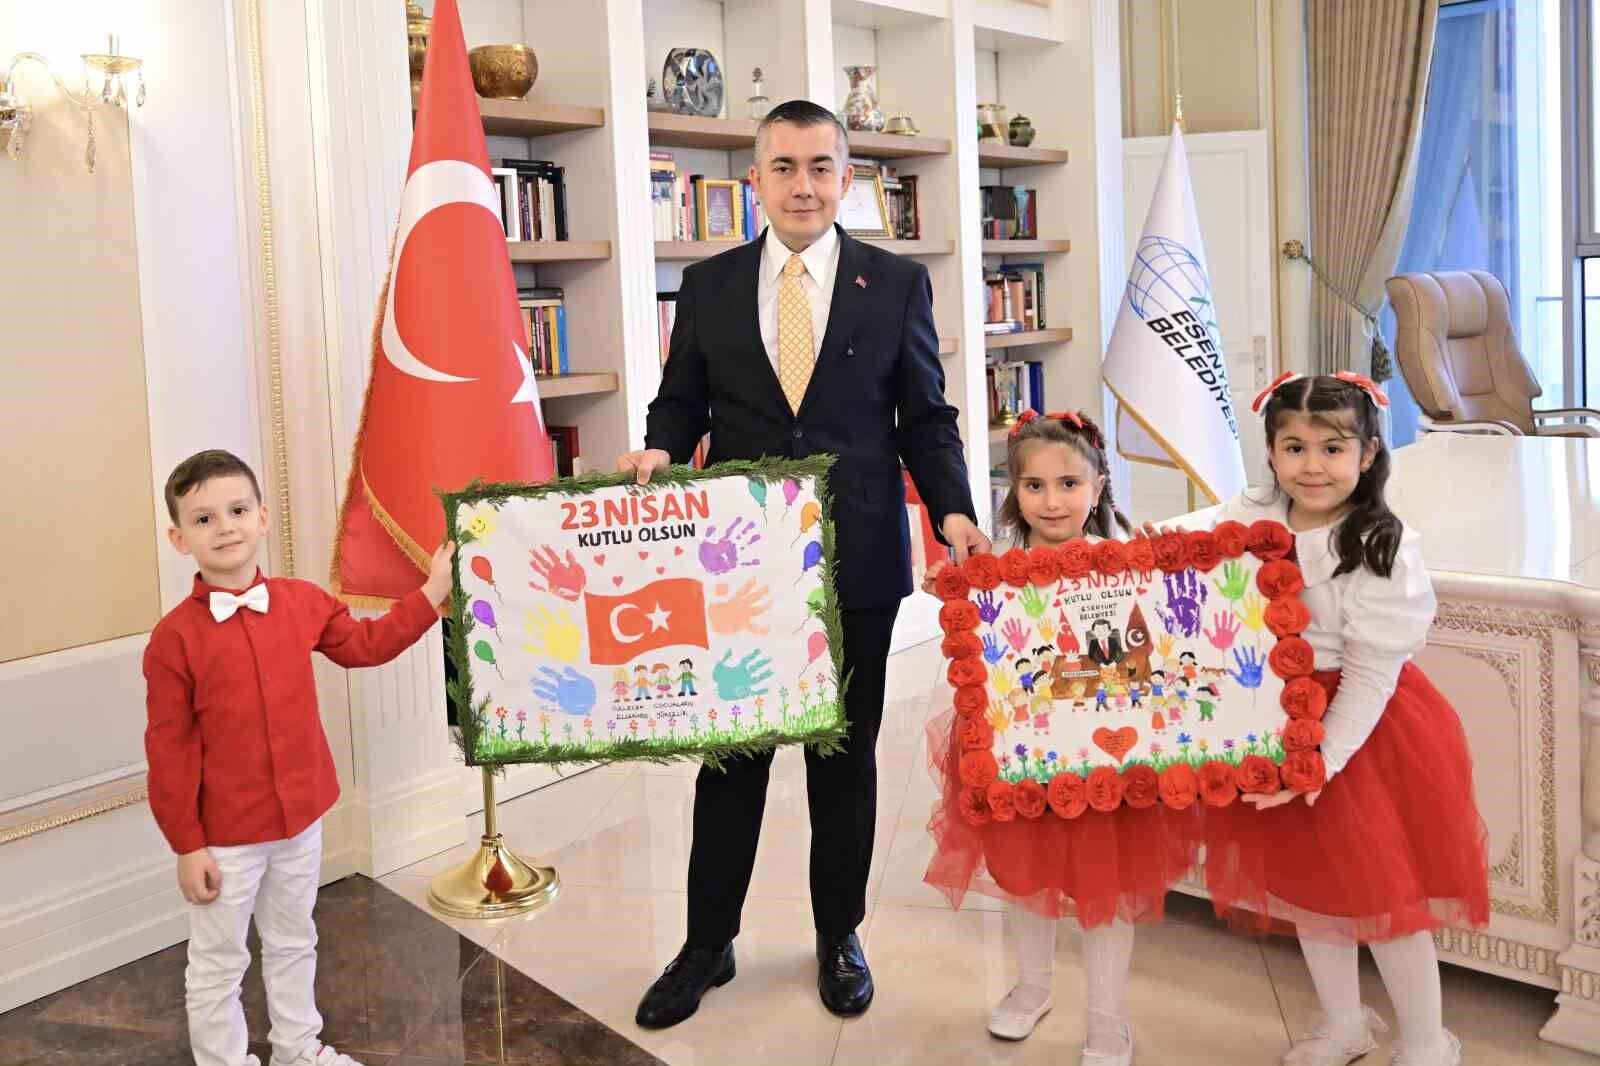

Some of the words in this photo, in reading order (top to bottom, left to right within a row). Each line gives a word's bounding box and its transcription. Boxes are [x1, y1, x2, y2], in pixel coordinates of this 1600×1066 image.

[1171, 309, 1231, 399] ESENY
[560, 499, 600, 530] 23
[578, 529, 632, 548] KUTLU
[638, 523, 696, 542] OLSUN
[1064, 592, 1092, 605] KUTLU
[1100, 588, 1132, 599] OLSUN
